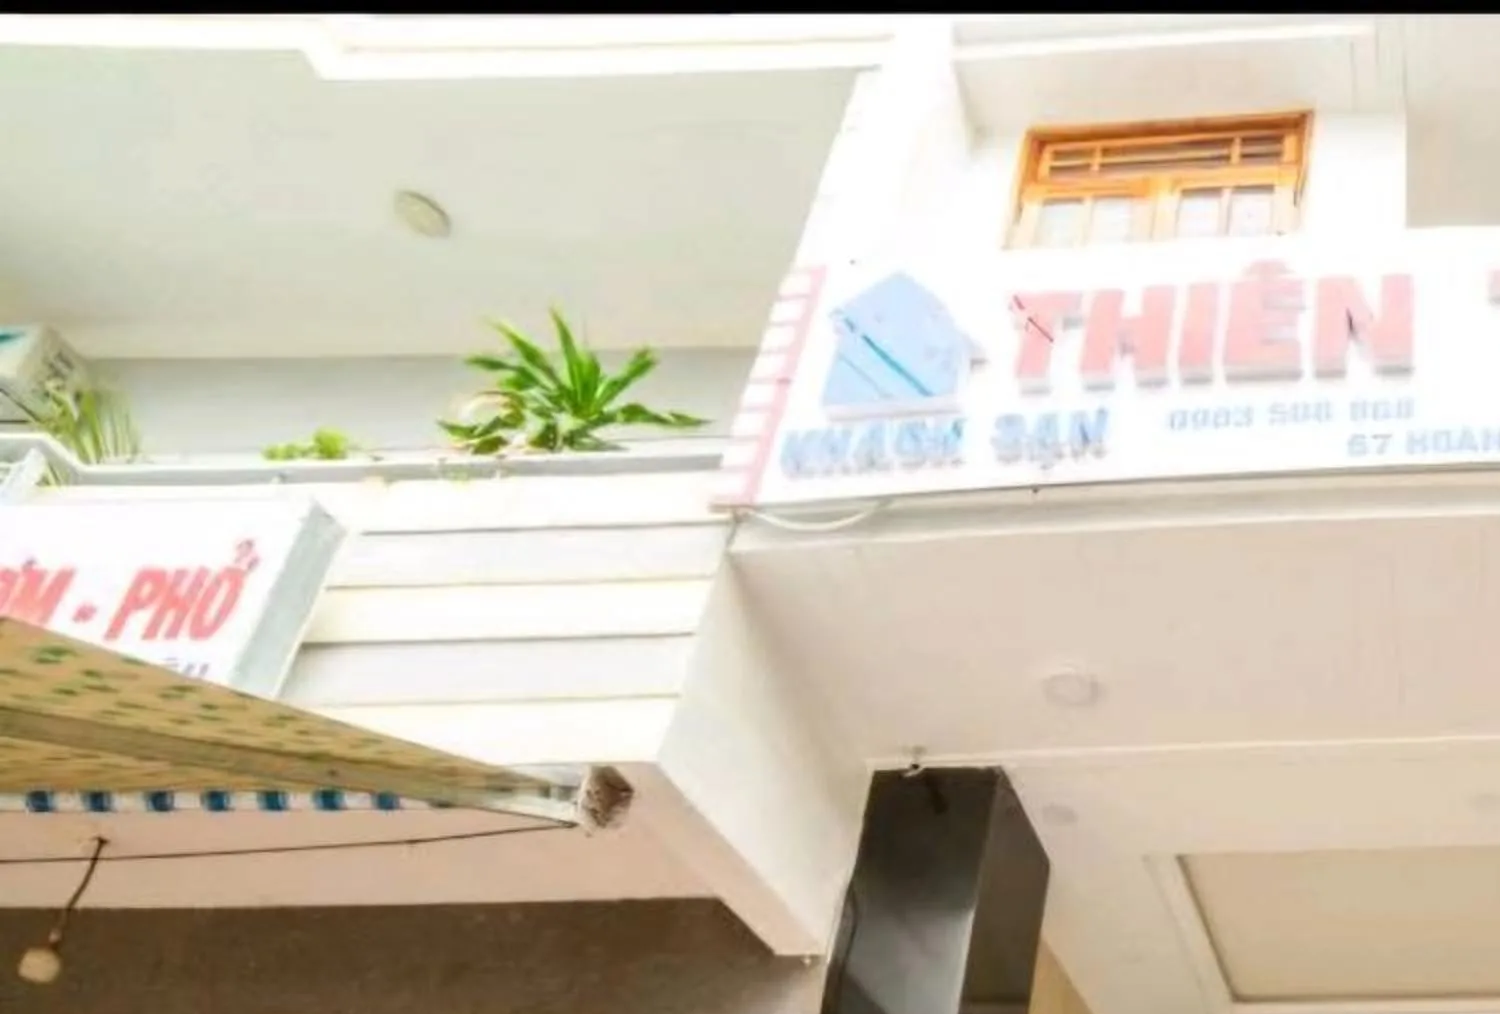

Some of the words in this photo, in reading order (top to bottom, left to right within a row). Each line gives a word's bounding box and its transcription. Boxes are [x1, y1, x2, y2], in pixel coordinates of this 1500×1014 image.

[1008, 259, 1414, 394] THIÊN
[1347, 432, 1393, 457] 67
[103, 538, 260, 642] PHỞ
